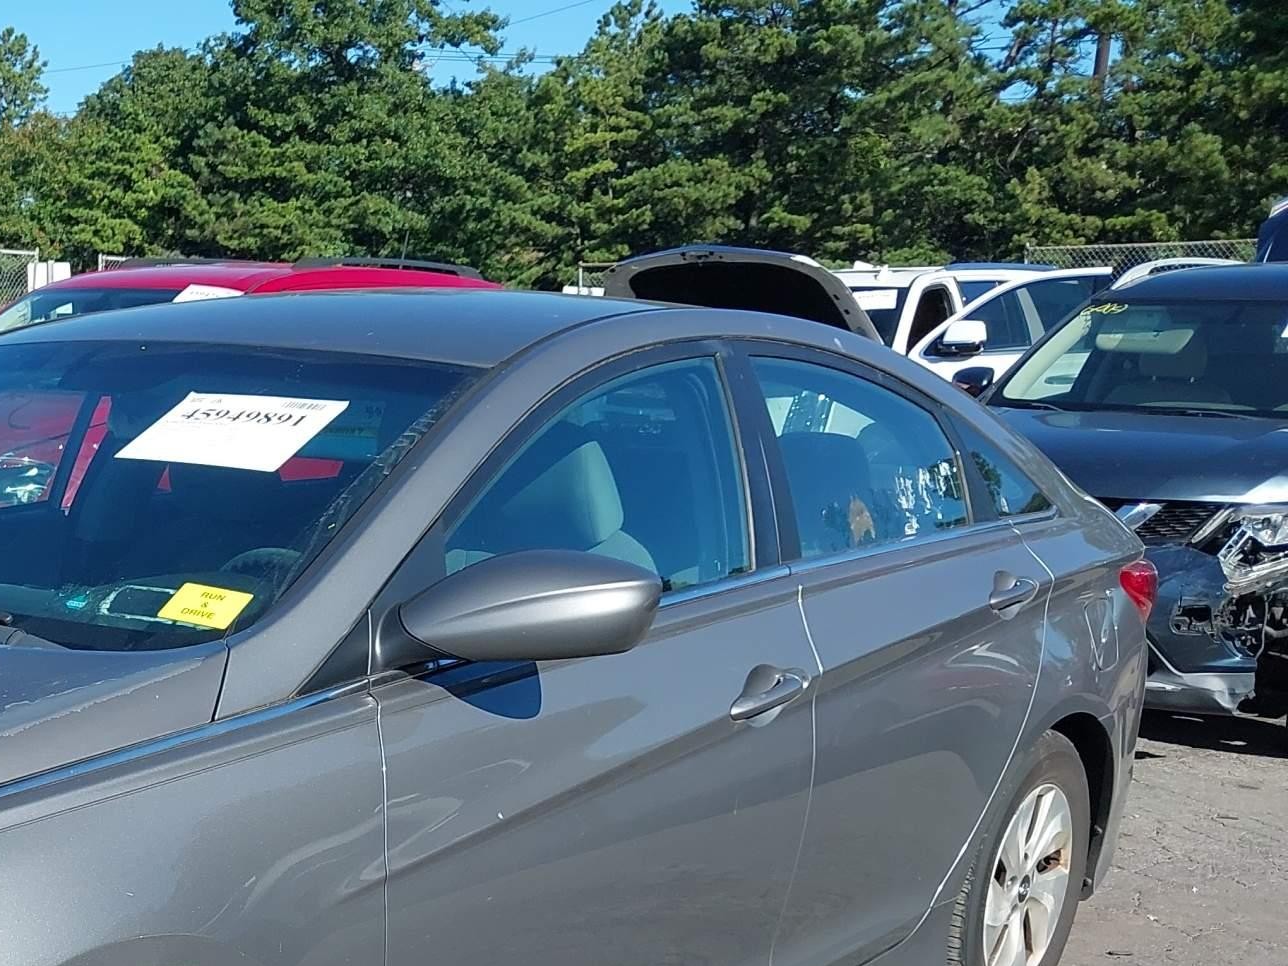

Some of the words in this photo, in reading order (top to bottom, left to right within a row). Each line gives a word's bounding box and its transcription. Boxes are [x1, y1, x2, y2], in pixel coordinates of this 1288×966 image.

[181, 407, 308, 428] 45949891
[200, 591, 227, 602] RUN
[180, 607, 216, 620] DRIVE
